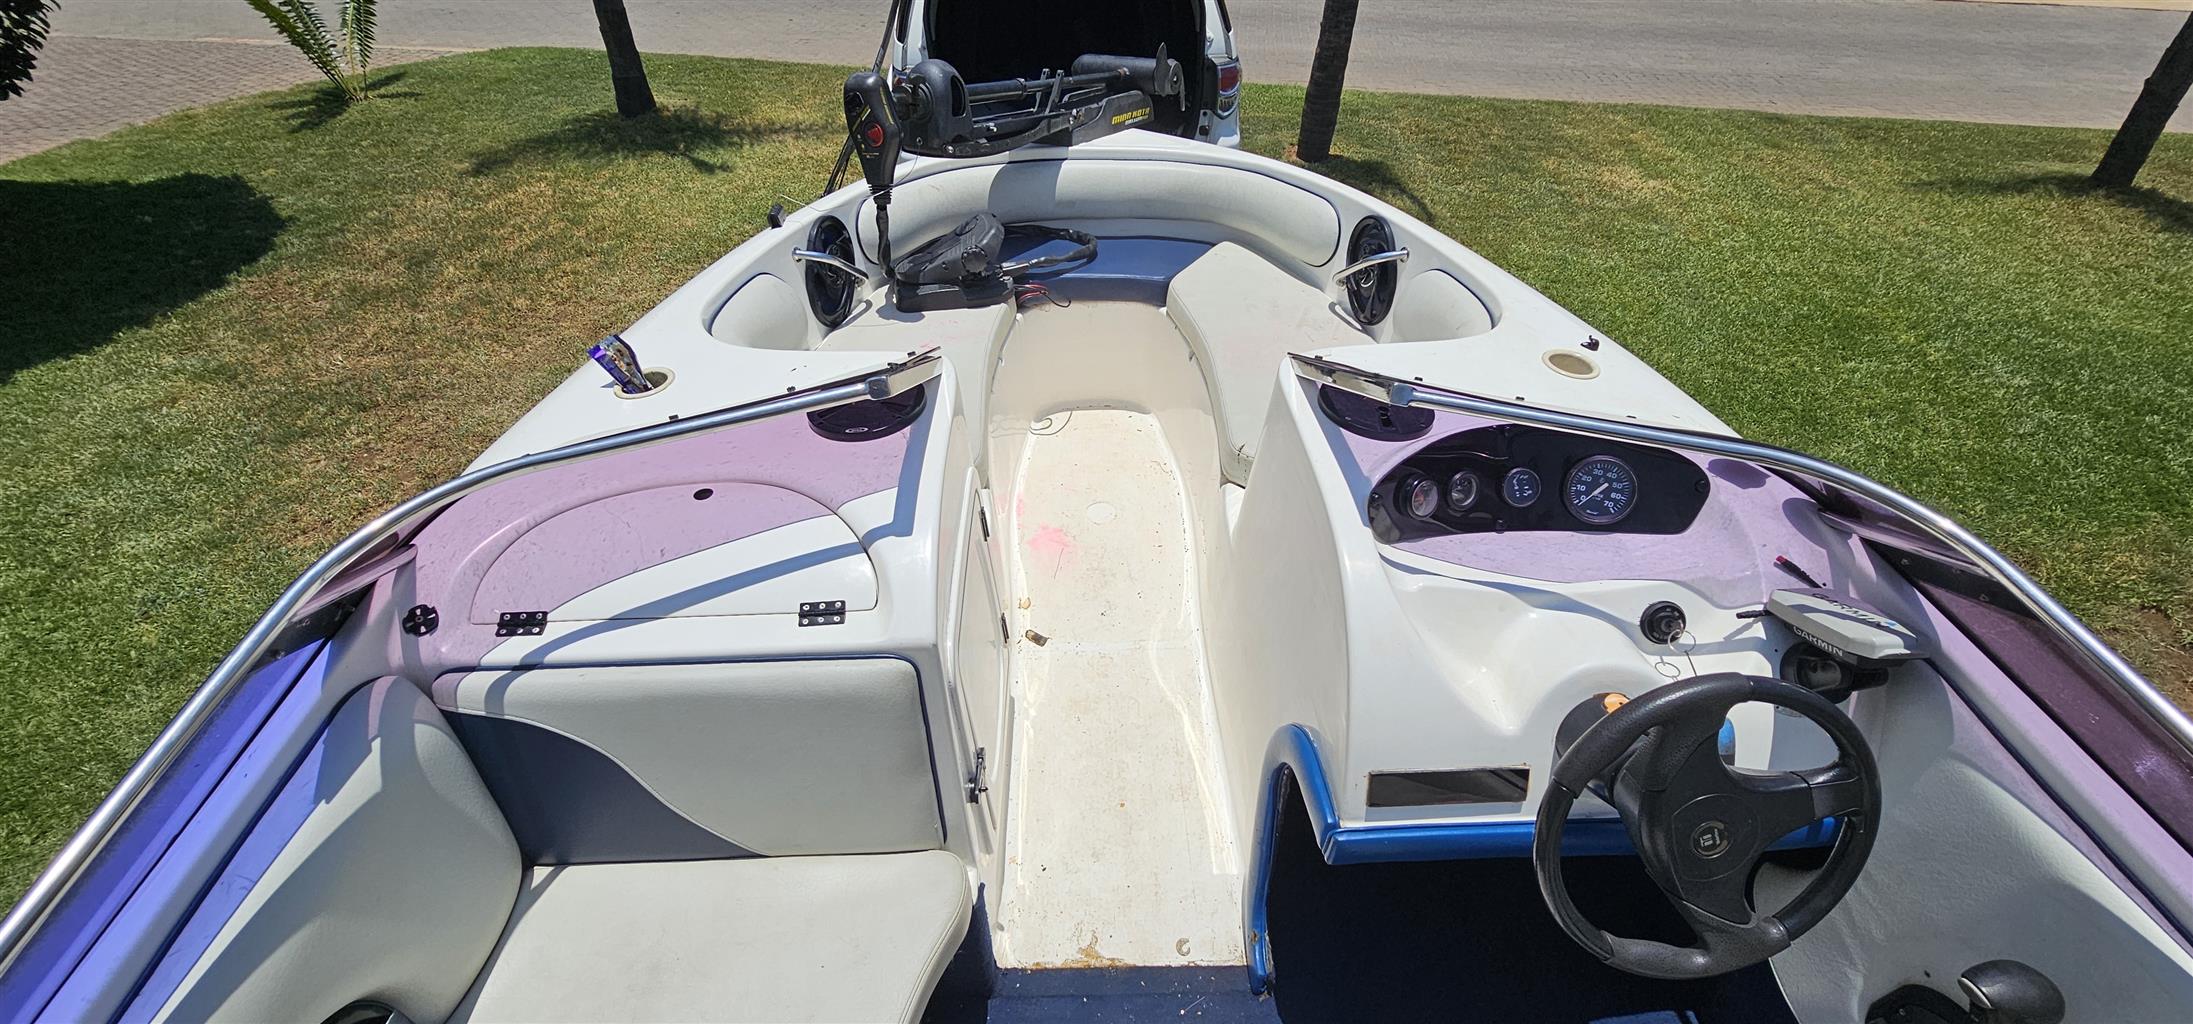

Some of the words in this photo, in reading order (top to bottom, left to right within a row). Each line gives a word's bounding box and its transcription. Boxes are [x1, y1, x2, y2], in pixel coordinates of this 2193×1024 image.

[1593, 468, 1604, 476] 30
[1606, 471, 1618, 479] 40
[1581, 474, 1592, 482] 20
[1610, 492, 1622, 500] 60
[1603, 500, 1614, 508] 70
[1793, 626, 1843, 657] GARMIN
